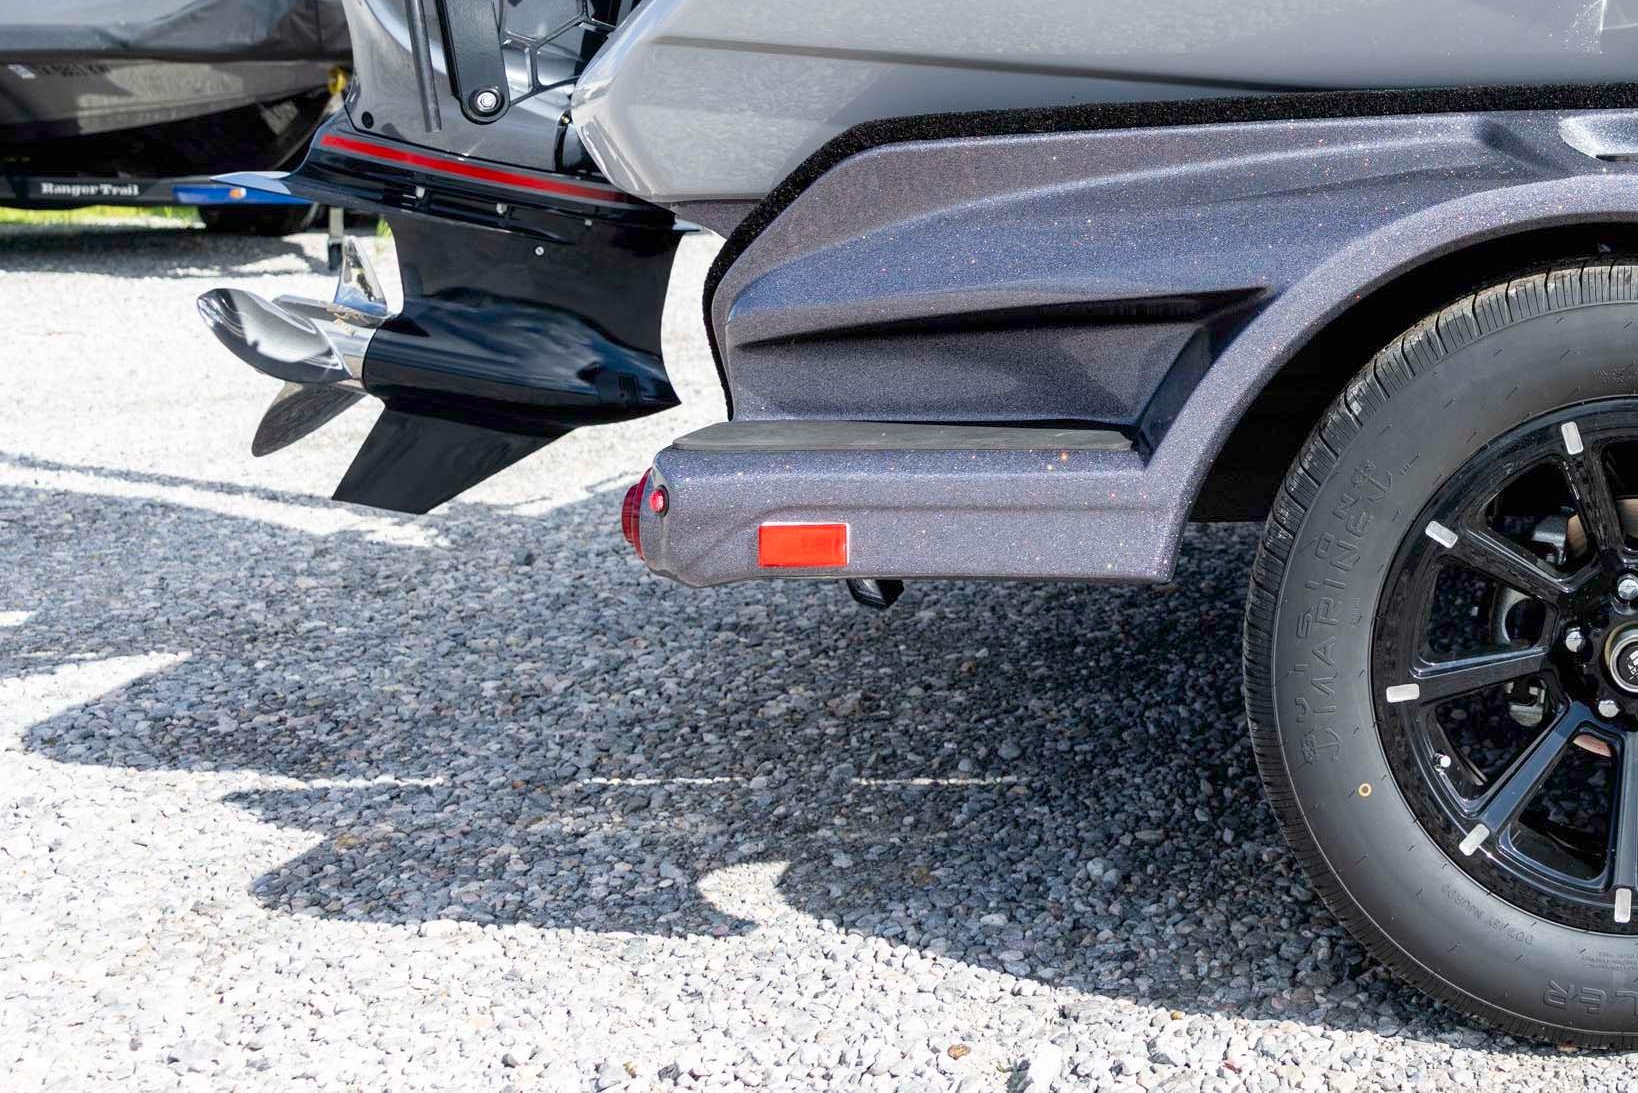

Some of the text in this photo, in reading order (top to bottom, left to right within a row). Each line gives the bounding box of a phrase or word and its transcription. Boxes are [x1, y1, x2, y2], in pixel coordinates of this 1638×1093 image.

[41, 183, 139, 197] Ranger Trail
[1310, 510, 1375, 714] MARINE
